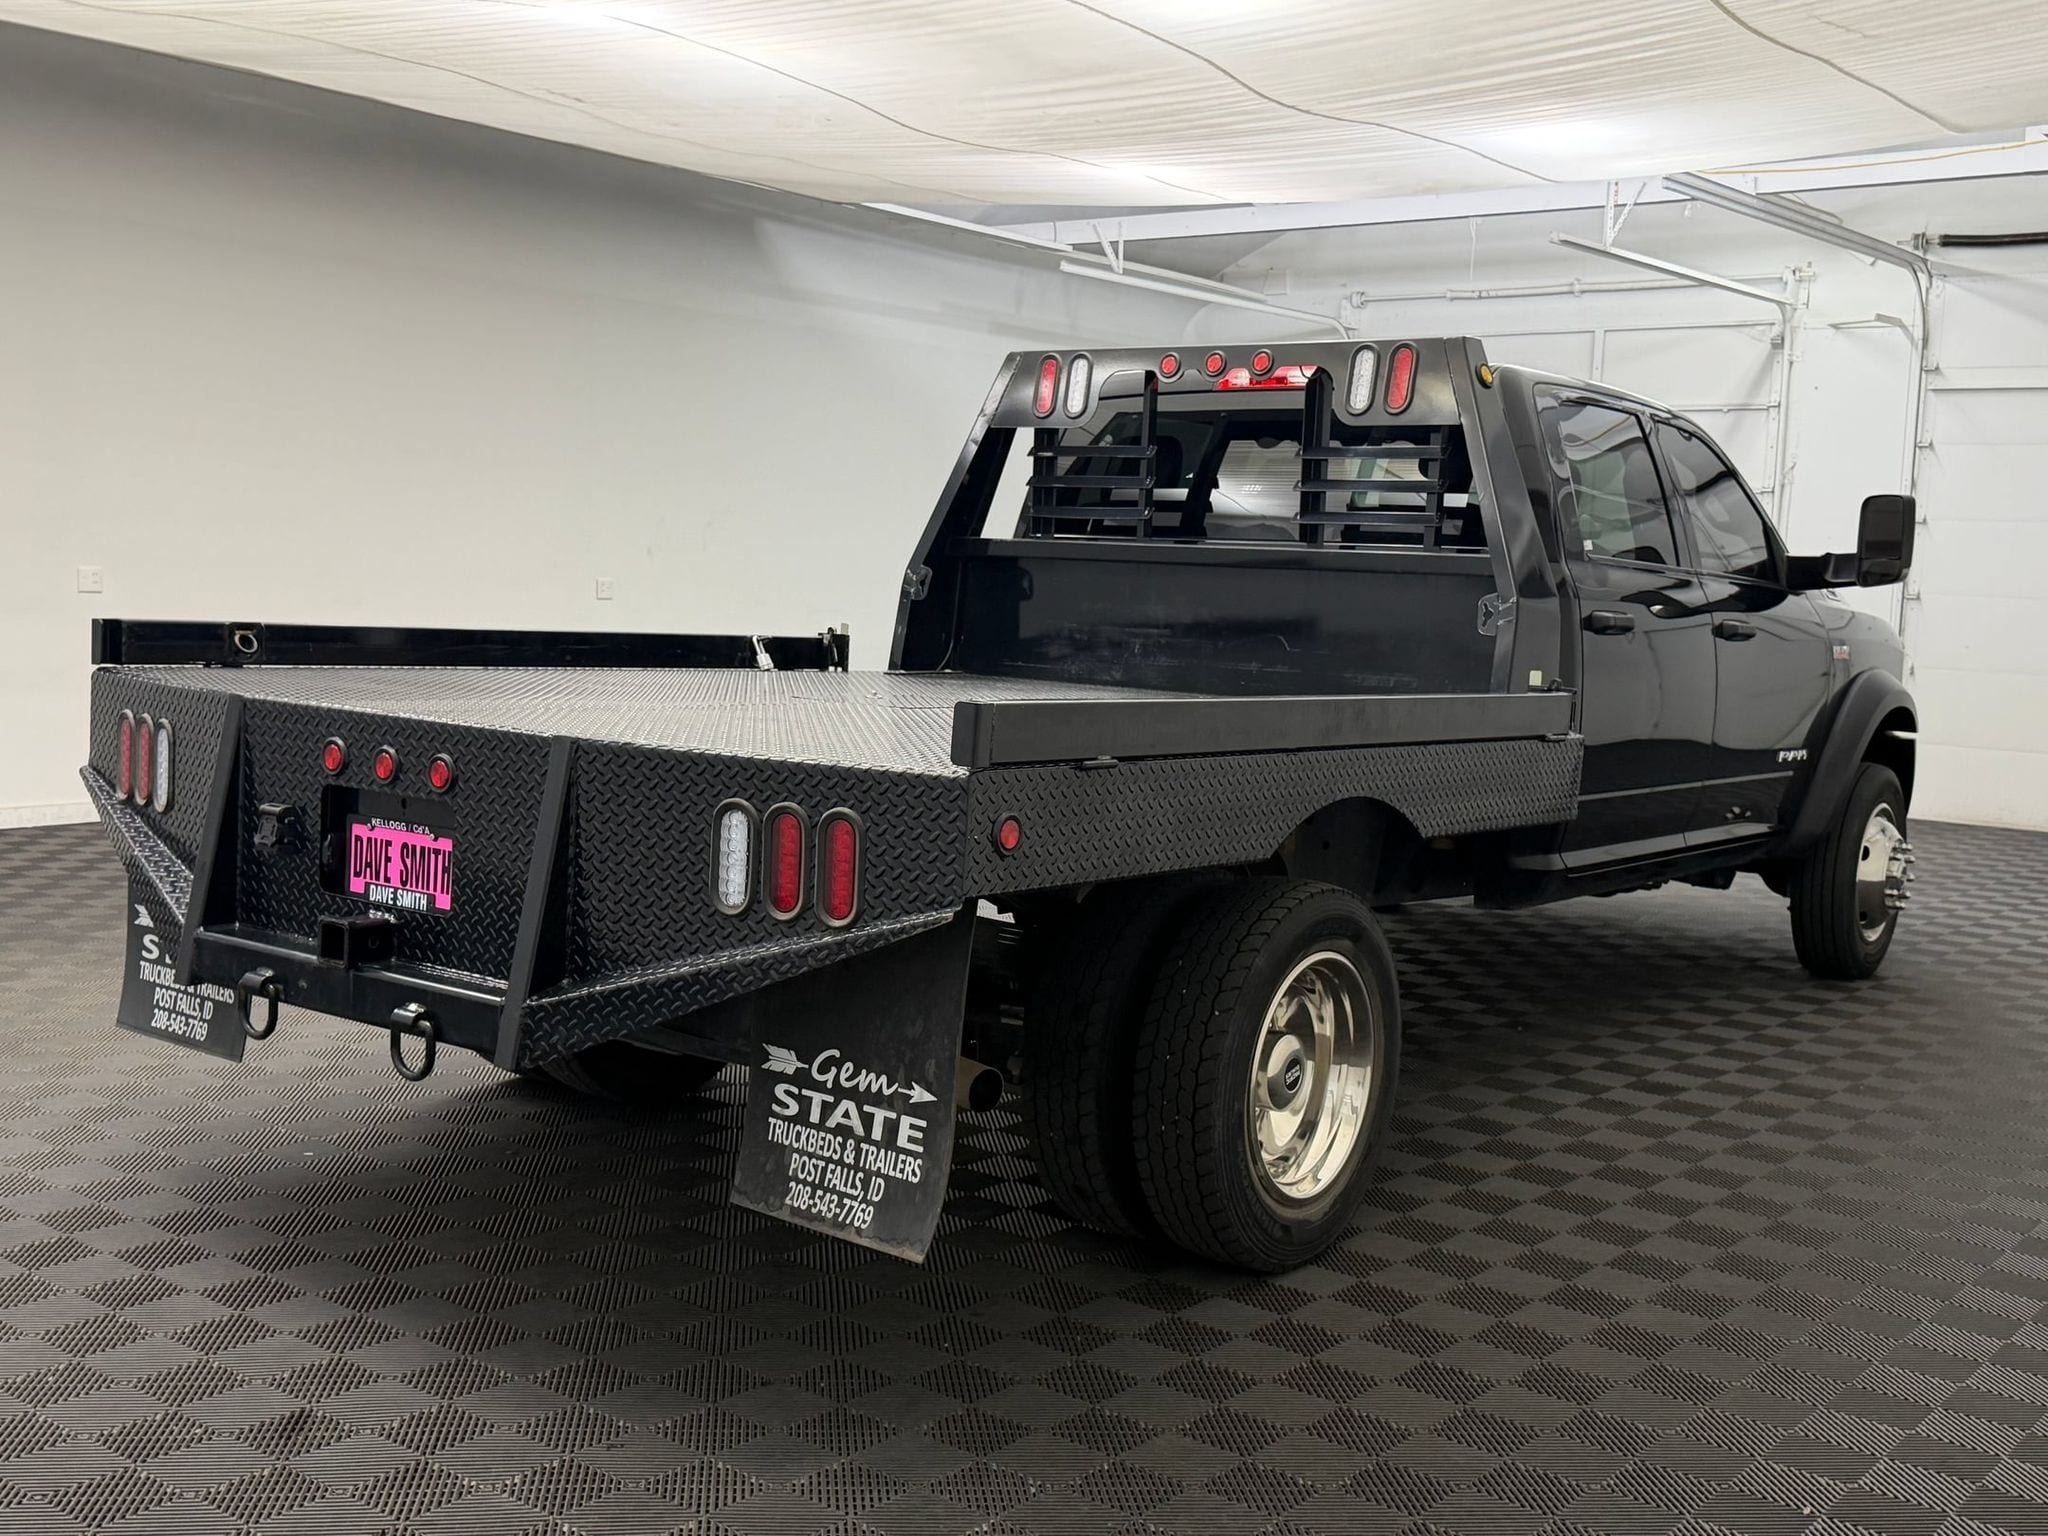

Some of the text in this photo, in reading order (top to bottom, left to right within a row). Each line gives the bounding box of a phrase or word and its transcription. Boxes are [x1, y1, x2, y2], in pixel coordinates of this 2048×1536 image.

[370, 817, 407, 832] KELLOGG
[353, 834, 453, 896] DAVE SMITH
[369, 885, 428, 911] DAVE SMITH
[139, 961, 187, 990] TRUCKBE
[151, 1008, 208, 1042] 208-543-7769
[153, 987, 178, 1010] POST
[202, 1004, 214, 1020] ID
[811, 1049, 899, 1096] Gem
[771, 1083, 928, 1153] STATE
[768, 1116, 923, 1184] TRUCKBEDS & TRAILERS
[788, 1152, 885, 1202] POST FALLS, ID
[785, 1181, 874, 1230] 208-543-7769
